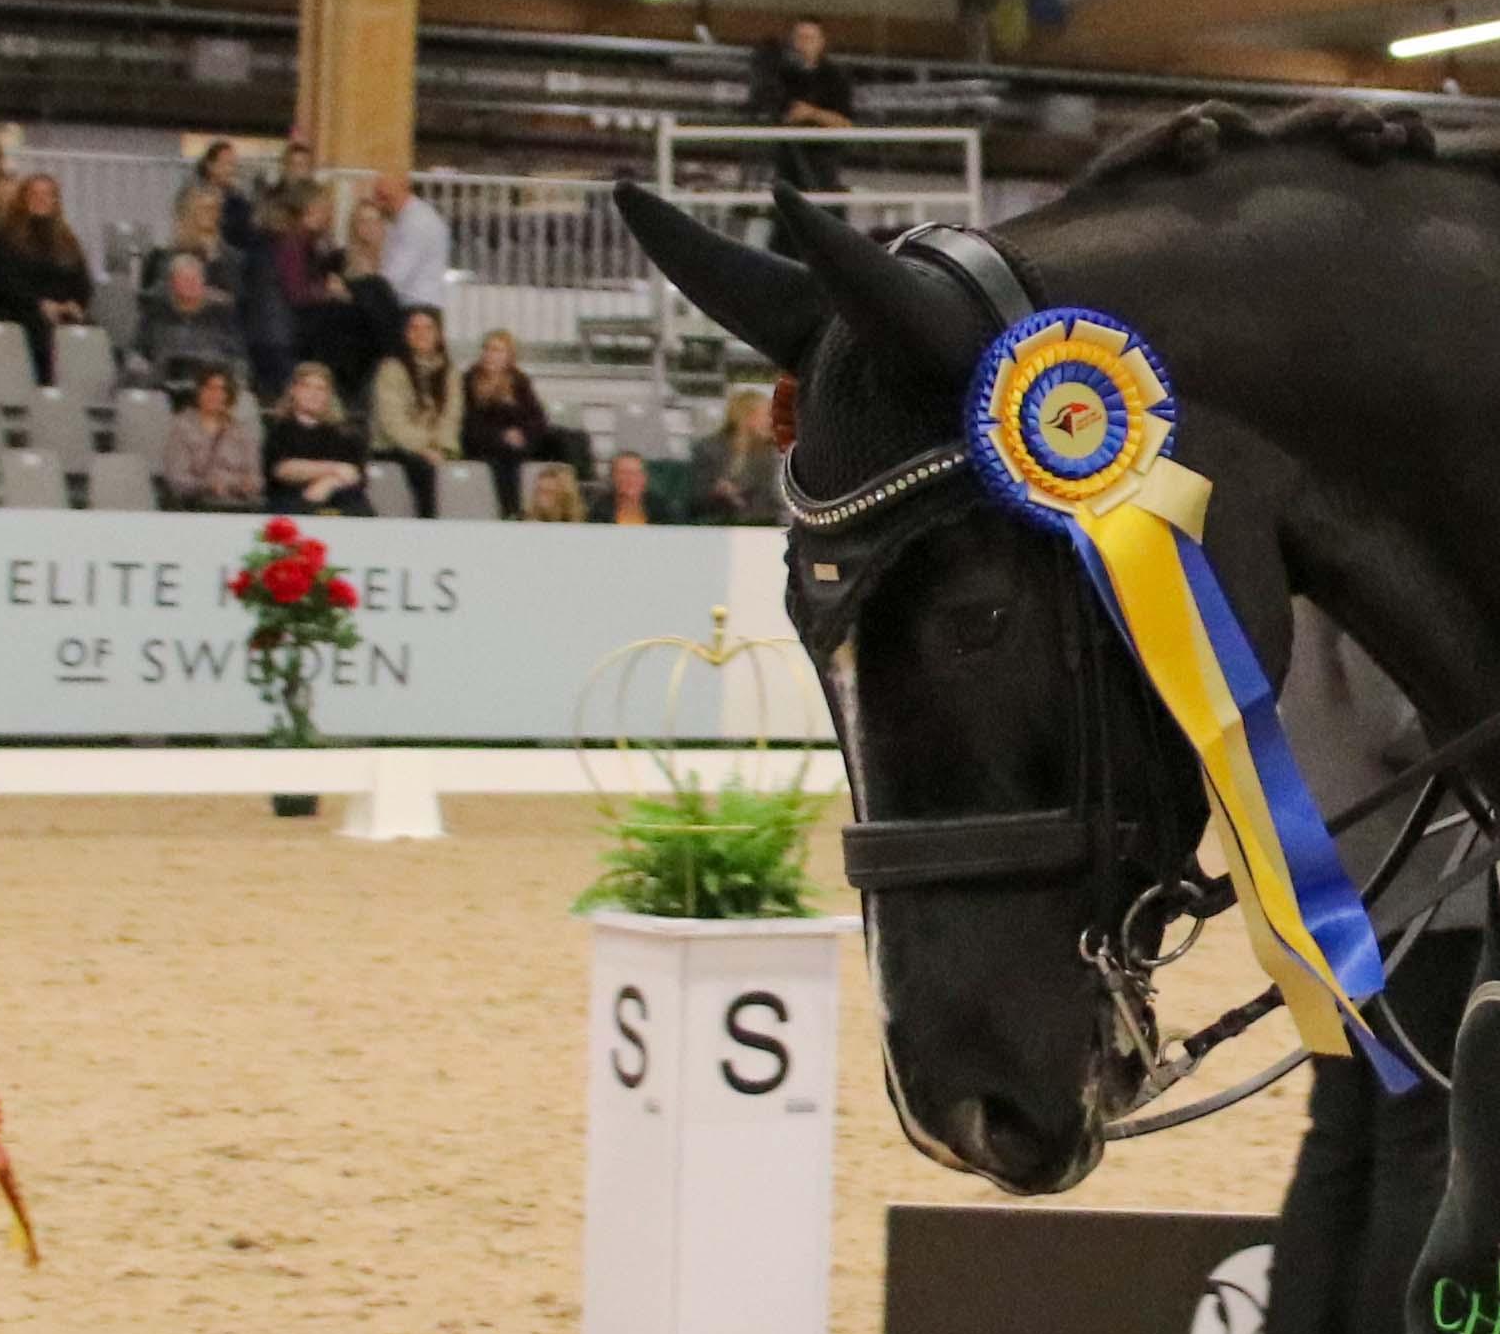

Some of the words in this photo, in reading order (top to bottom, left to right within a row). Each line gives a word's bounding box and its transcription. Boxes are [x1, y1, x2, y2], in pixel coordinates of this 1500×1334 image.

[8, 559, 182, 608] ELITE
[56, 637, 113, 669] OF
[611, 985, 648, 1089] S
[720, 991, 789, 1095] S
